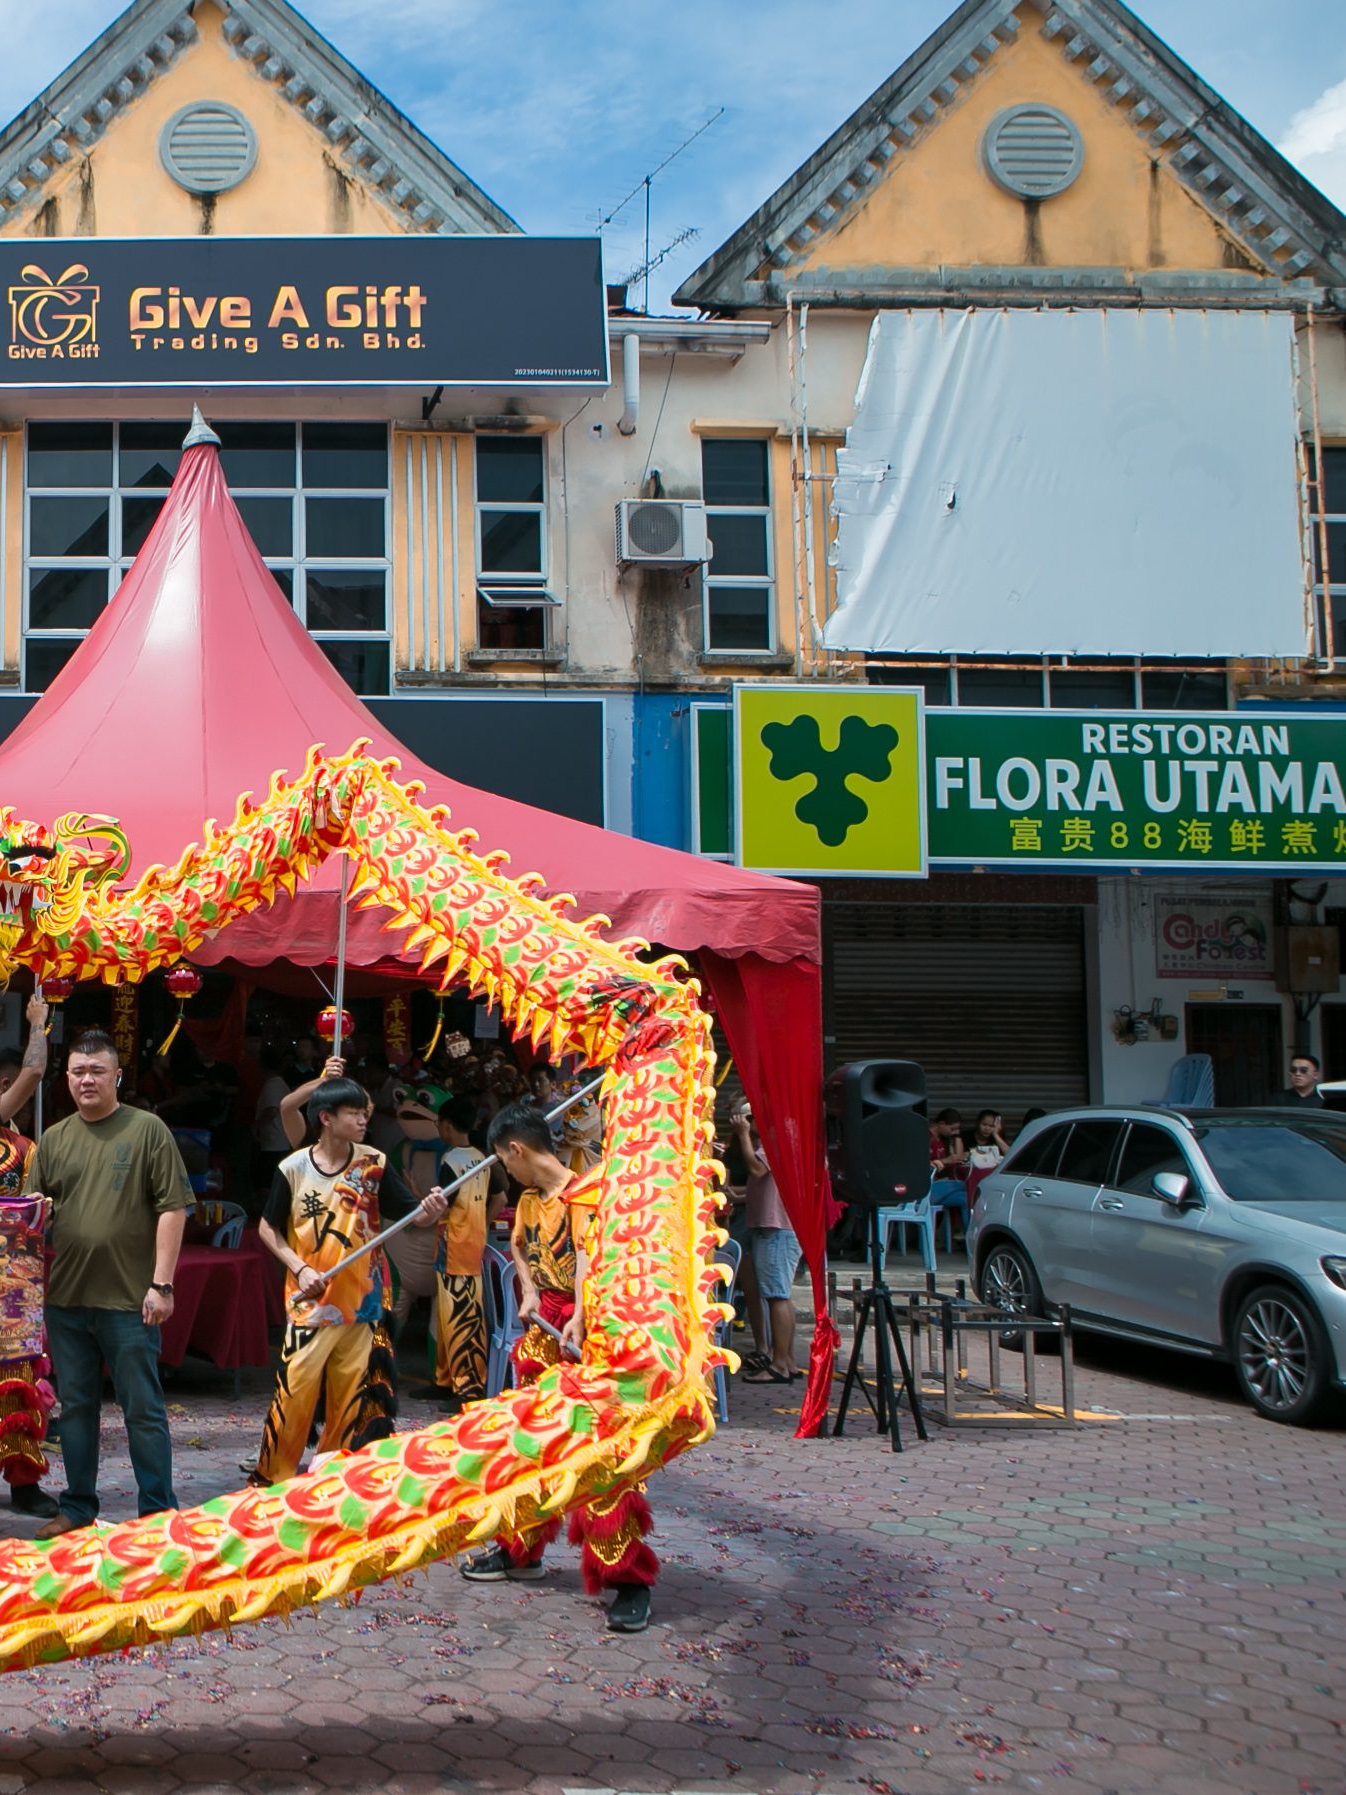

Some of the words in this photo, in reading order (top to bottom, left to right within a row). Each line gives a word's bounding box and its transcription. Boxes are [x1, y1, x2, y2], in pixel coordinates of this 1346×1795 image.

[129, 287, 251, 331] Give
[267, 286, 310, 328] A
[326, 286, 427, 329] Gift
[8, 344, 47, 359] Give
[51, 344, 64, 358] A
[68, 343, 101, 358] Gift
[131, 333, 259, 353] Trading
[282, 333, 344, 349] Sdn.
[363, 333, 425, 349] Bhd.
[1081, 723, 1290, 756] RESTORAN
[935, 757, 1124, 812] FLORA
[1143, 759, 1346, 814] UTAMA
[300, 1189, 353, 1253] 華人
